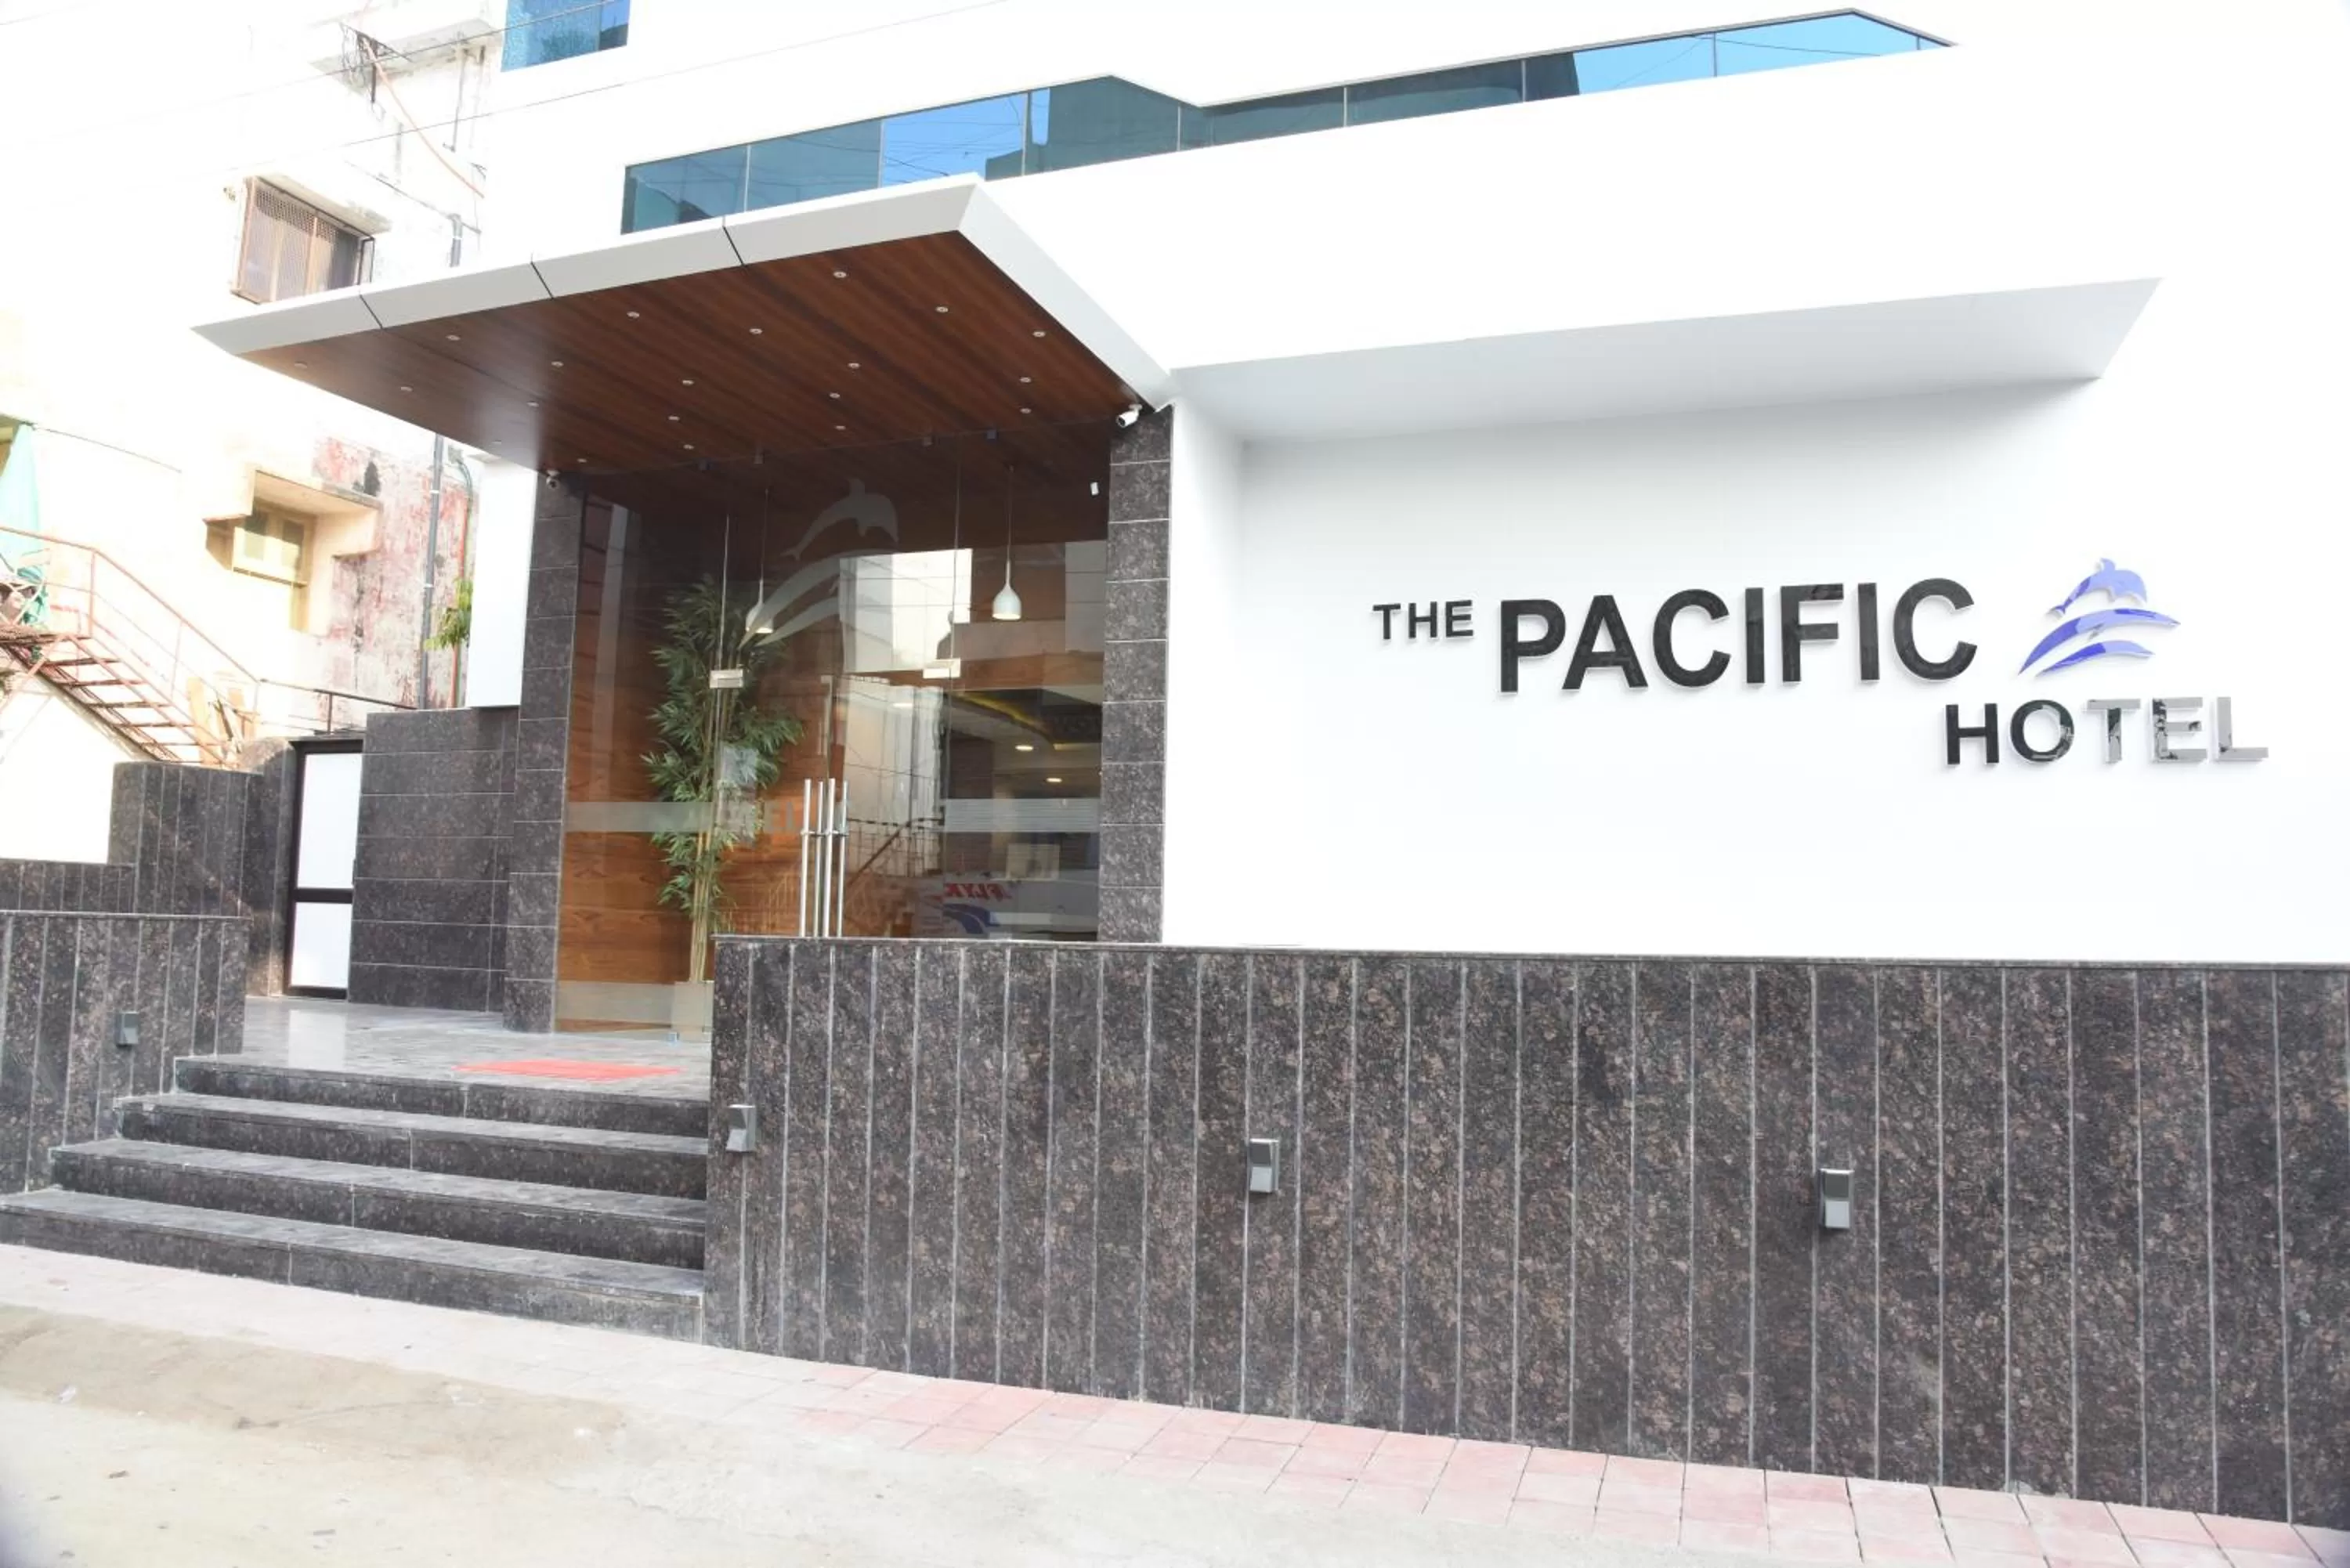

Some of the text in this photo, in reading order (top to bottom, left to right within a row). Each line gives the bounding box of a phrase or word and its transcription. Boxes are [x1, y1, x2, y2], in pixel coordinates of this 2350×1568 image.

[1372, 578, 1978, 693] THE PACIFIC
[1946, 697, 2269, 766] HOTEL
